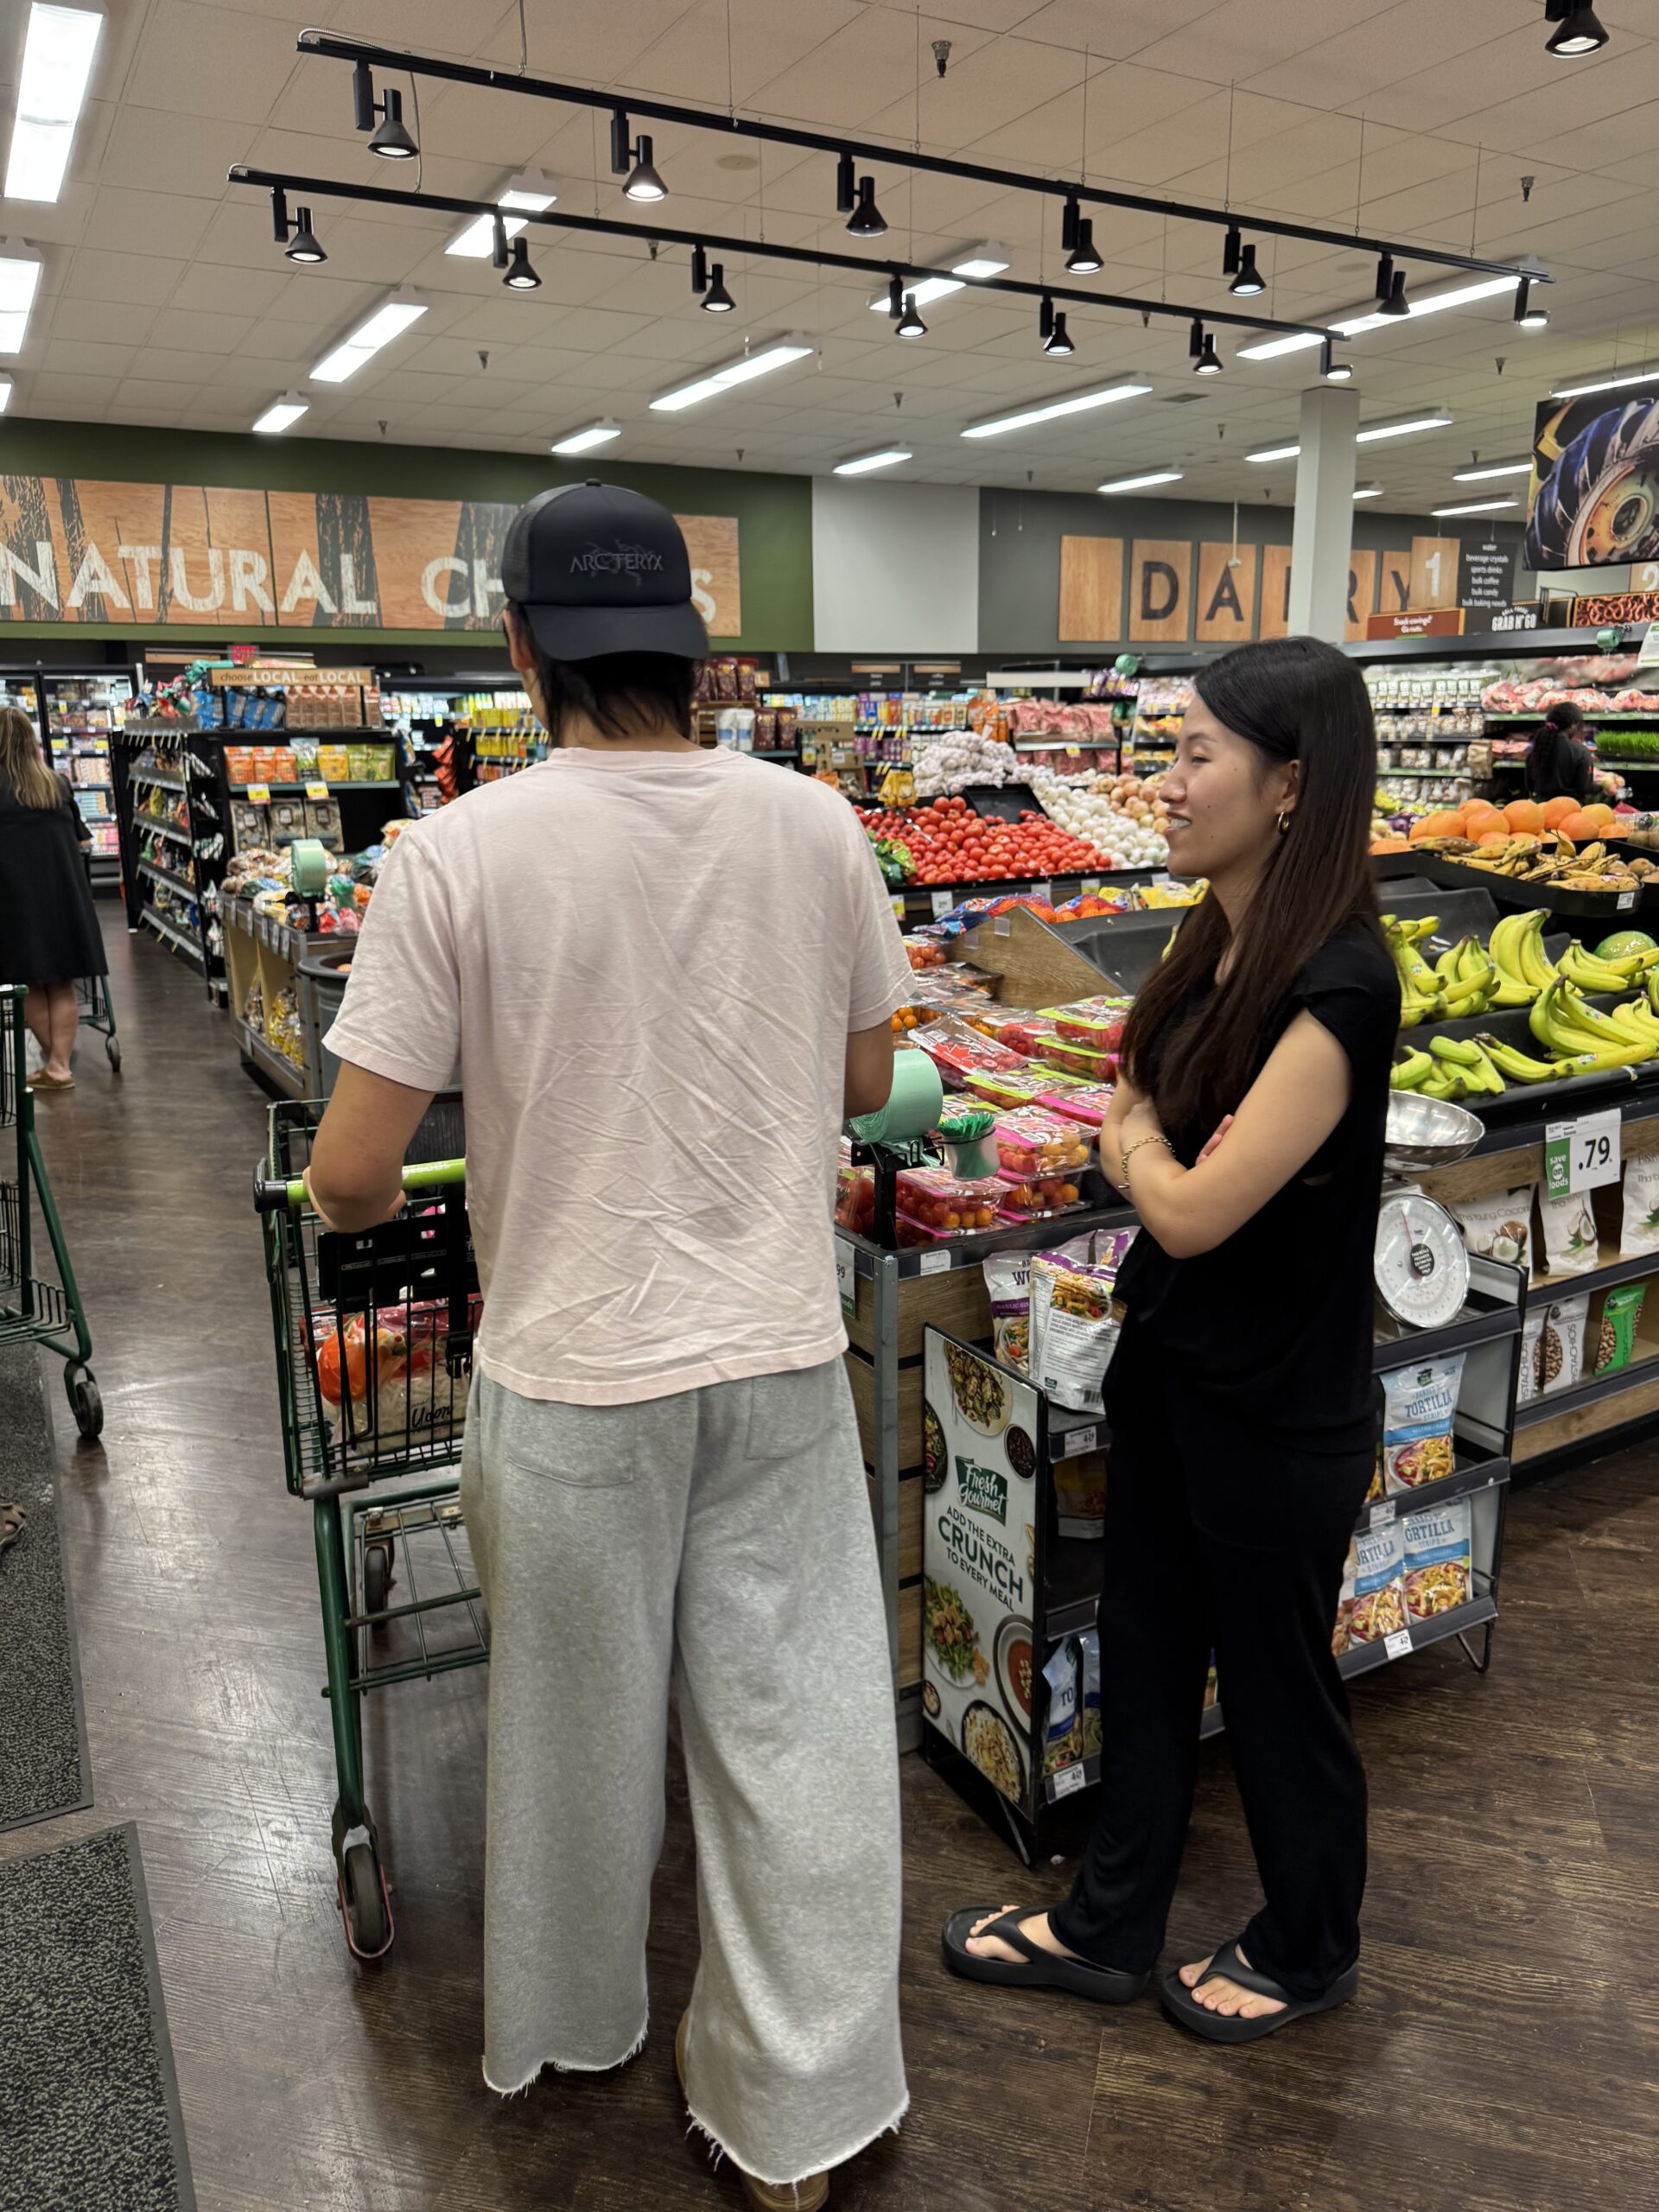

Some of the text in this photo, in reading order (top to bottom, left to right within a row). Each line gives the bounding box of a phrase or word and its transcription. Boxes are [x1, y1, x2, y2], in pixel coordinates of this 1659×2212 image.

[0, 540, 378, 614] NATURAL
[1426, 551, 1440, 596] 1
[1492, 615, 1514, 632] GRAB
[1524, 613, 1536, 629] GO
[220, 671, 364, 683] choose LOCAL eat LOCAL
[1550, 1154, 1567, 1165] save
[1579, 1136, 1610, 1170] .79
[1548, 1178, 1568, 1189] foods
[964, 1464, 999, 1497] Fresh
[958, 1484, 1009, 1515] gourmet
[947, 1504, 1015, 1567] ADD THE EXTRA
[1405, 1519, 1455, 1542] ORTILLA
[938, 1516, 1023, 1603] CRUNCH
[947, 1547, 1014, 1612] TO EVERY MEAL
